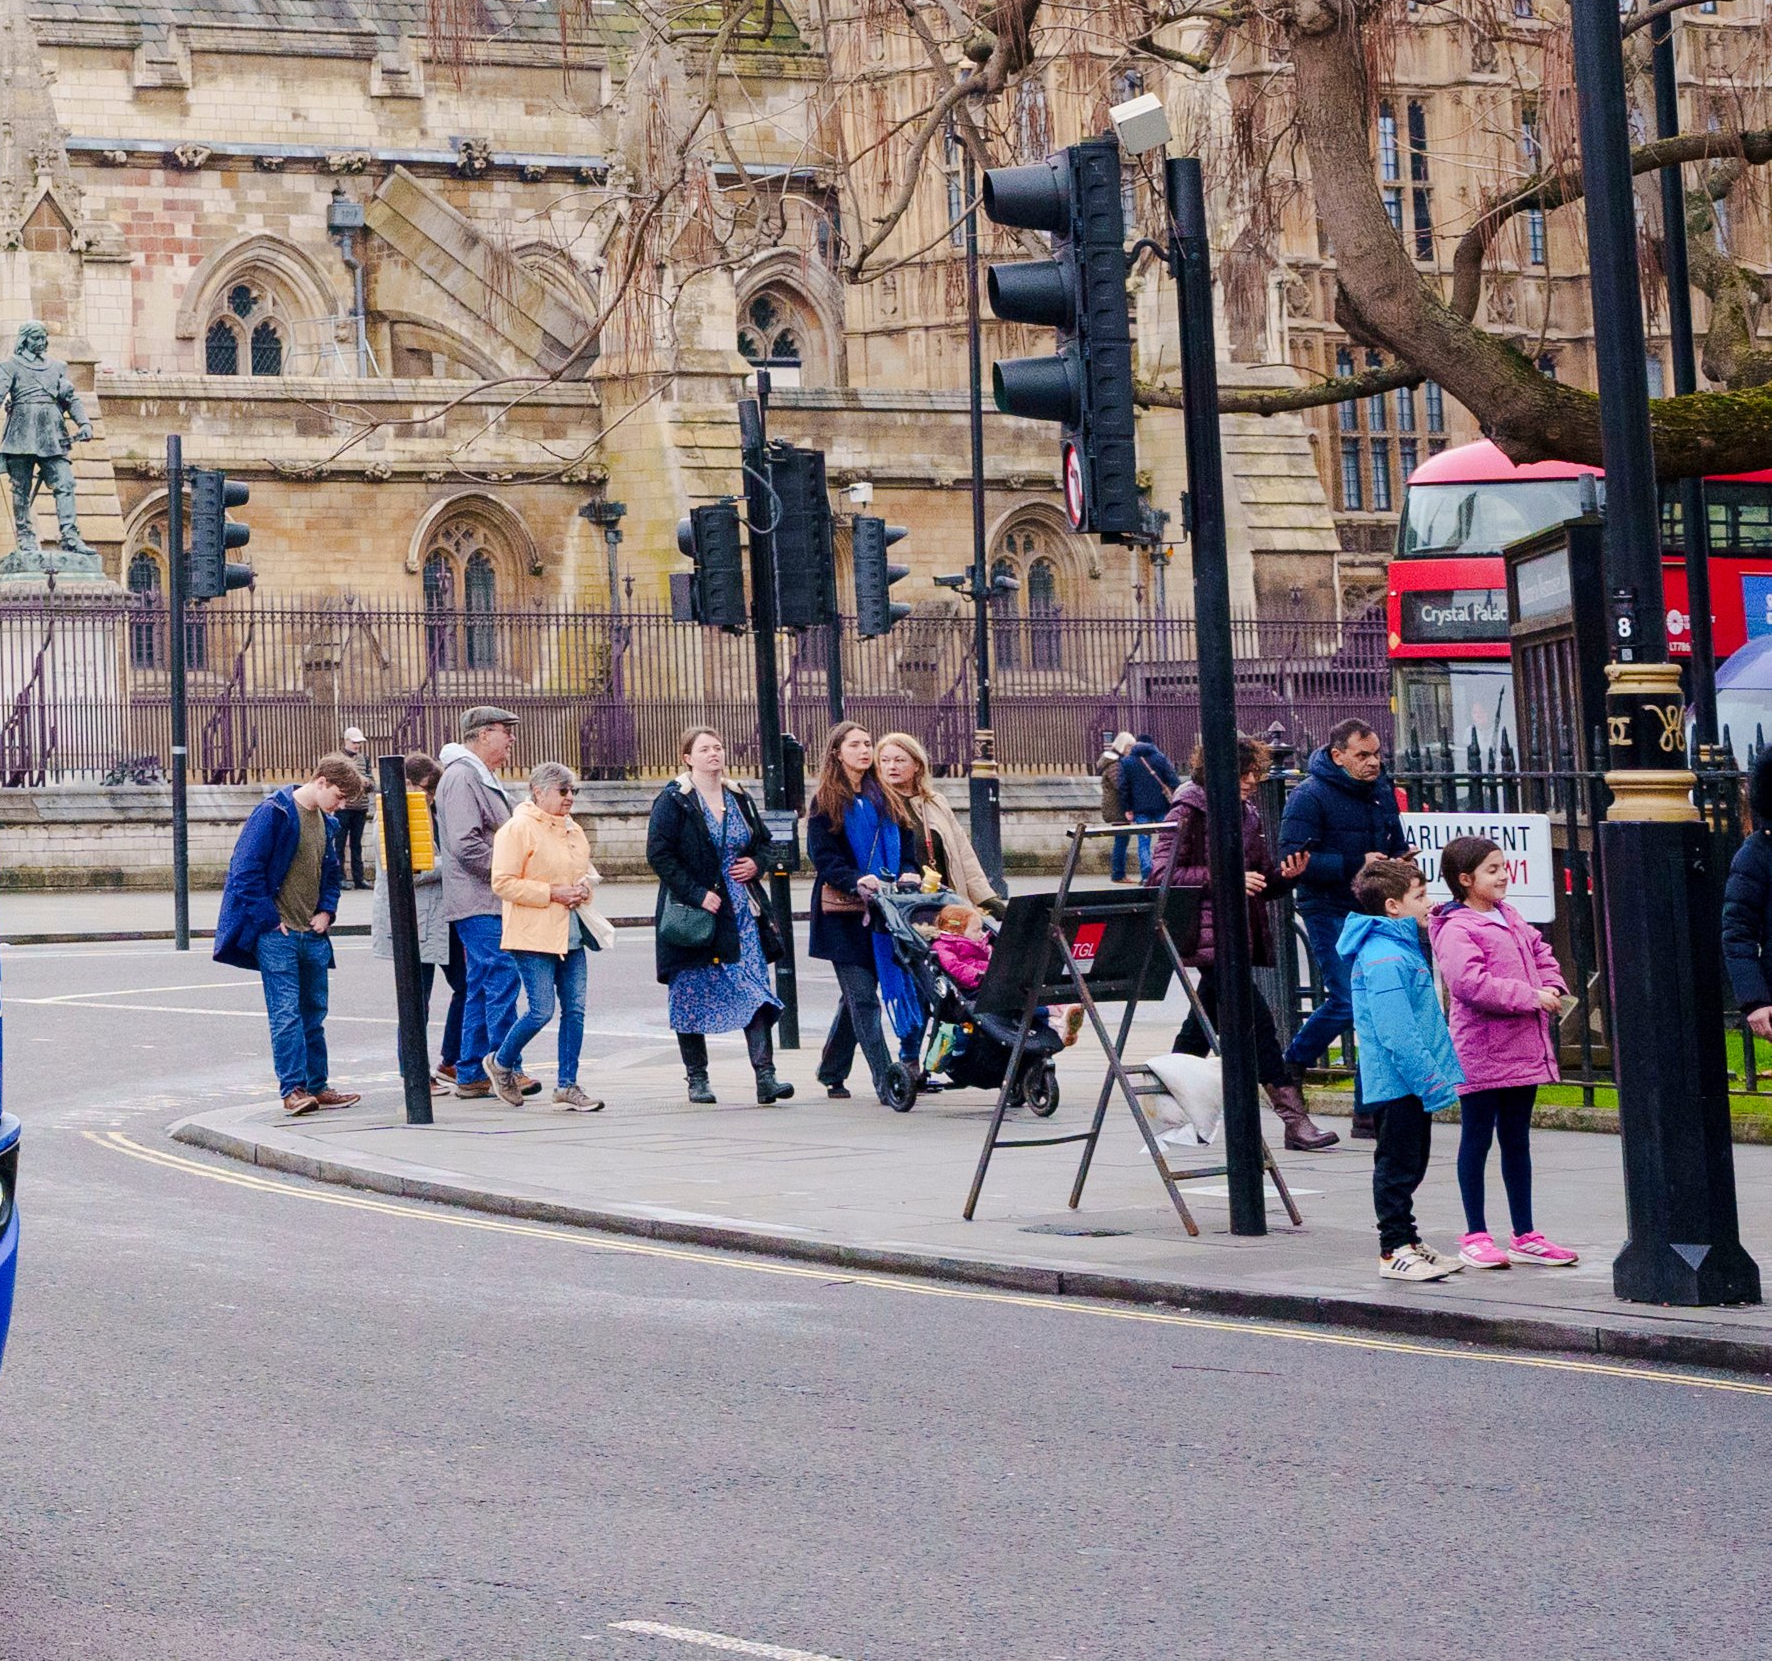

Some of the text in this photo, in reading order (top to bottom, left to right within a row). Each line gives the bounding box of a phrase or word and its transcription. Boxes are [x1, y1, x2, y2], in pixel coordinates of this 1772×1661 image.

[1421, 604, 1509, 627] Crystal Palac
[1618, 617, 1632, 638] 8
[1406, 825, 1530, 852] ARLIENT
[1505, 859, 1529, 885] W1
[1072, 942, 1095, 958] TGL
